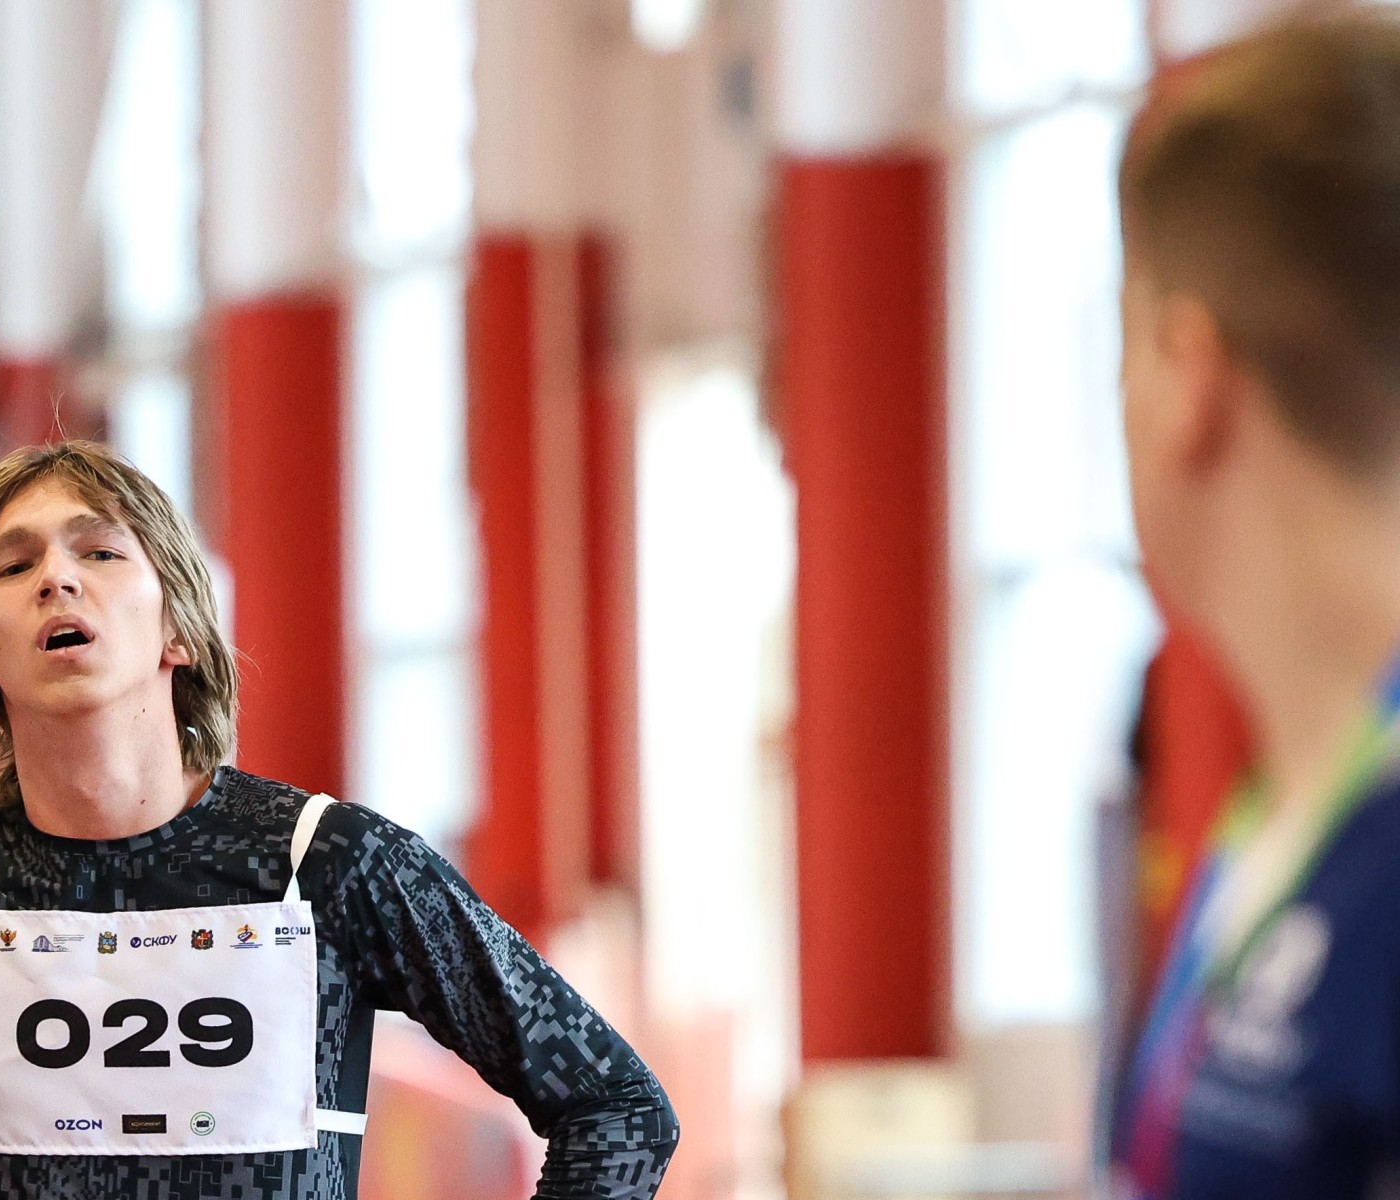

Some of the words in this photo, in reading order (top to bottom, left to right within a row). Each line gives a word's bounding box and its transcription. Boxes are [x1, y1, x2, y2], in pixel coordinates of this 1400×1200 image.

[143, 934, 178, 948] СКФУ
[16, 997, 254, 1069] 029
[55, 1119, 103, 1131] OZON
